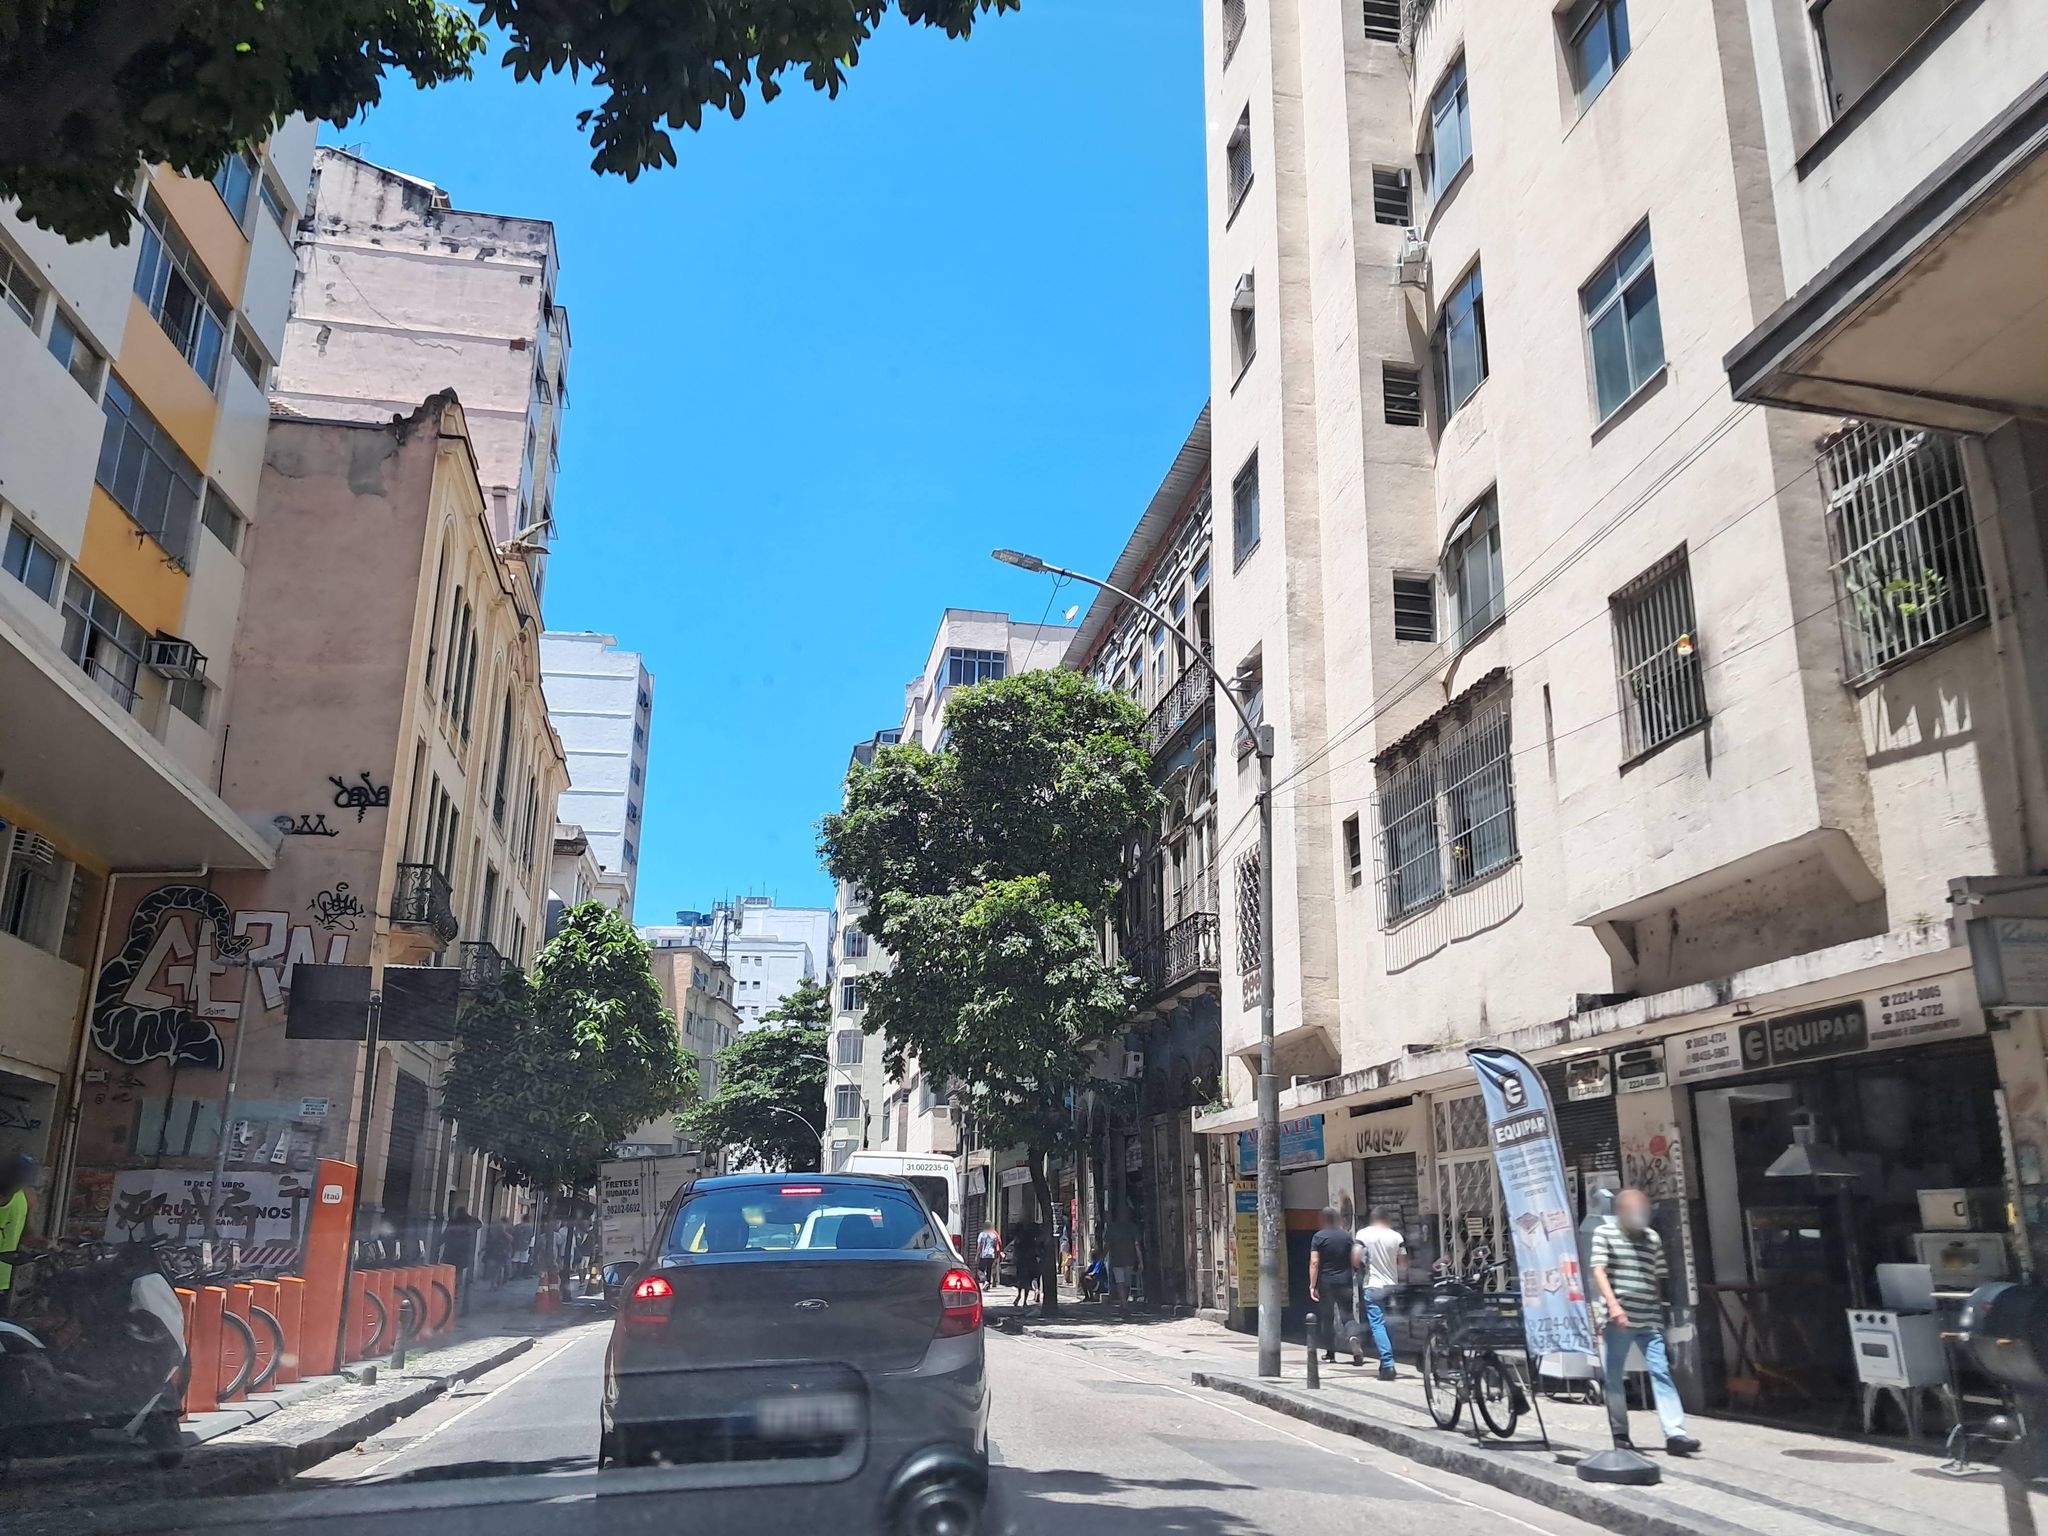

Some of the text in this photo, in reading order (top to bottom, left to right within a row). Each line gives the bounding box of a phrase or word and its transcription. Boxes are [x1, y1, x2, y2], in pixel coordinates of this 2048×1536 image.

[1772, 1012, 1863, 1051] EQUIPAR
[1495, 1116, 1547, 1143] EQUIPAR
[207, 1181, 245, 1189] OUBRO
[606, 1179, 639, 1189] FRETES E
[215, 1218, 248, 1226] SAMA
